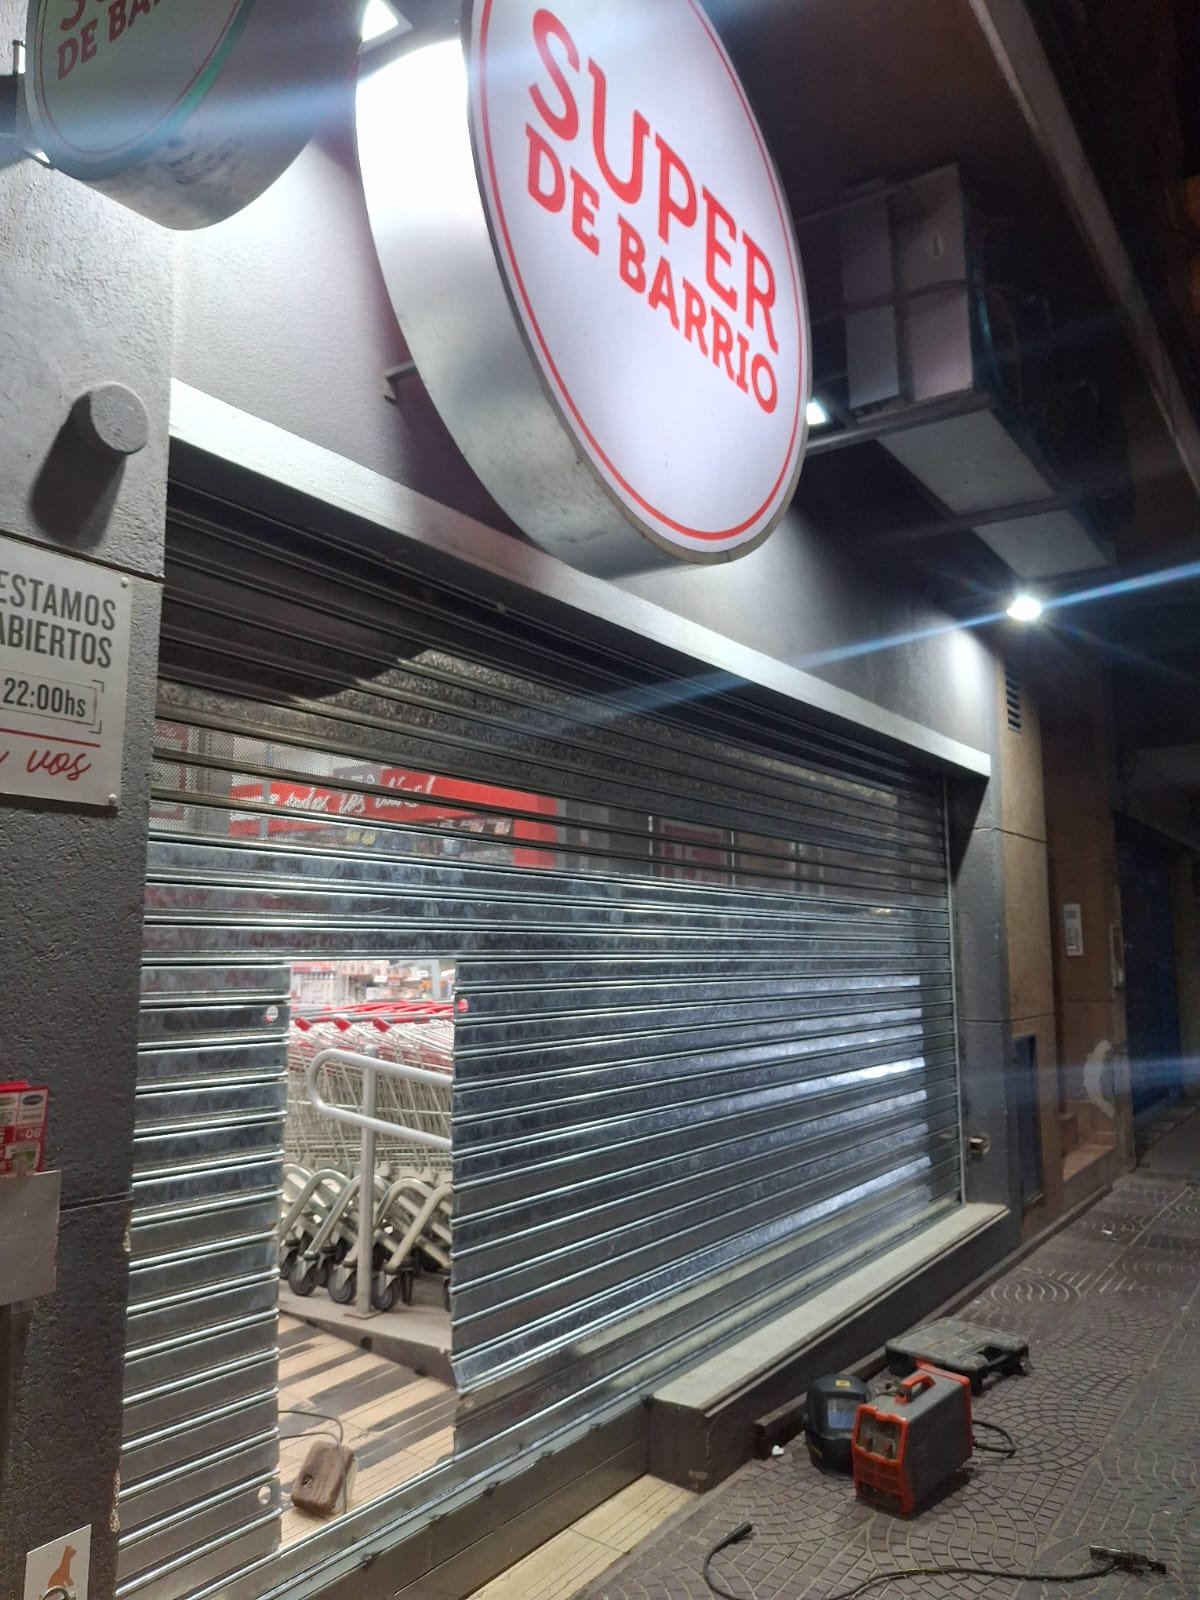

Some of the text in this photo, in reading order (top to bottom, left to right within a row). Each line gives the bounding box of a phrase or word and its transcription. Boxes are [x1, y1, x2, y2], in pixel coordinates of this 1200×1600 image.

[57, 18, 98, 80] DE
[528, 8, 779, 354] SUPER
[525, 123, 779, 414] DE BARRIO
[3, 676, 86, 718] 22:00hs
[26, 749, 92, 781] vos
